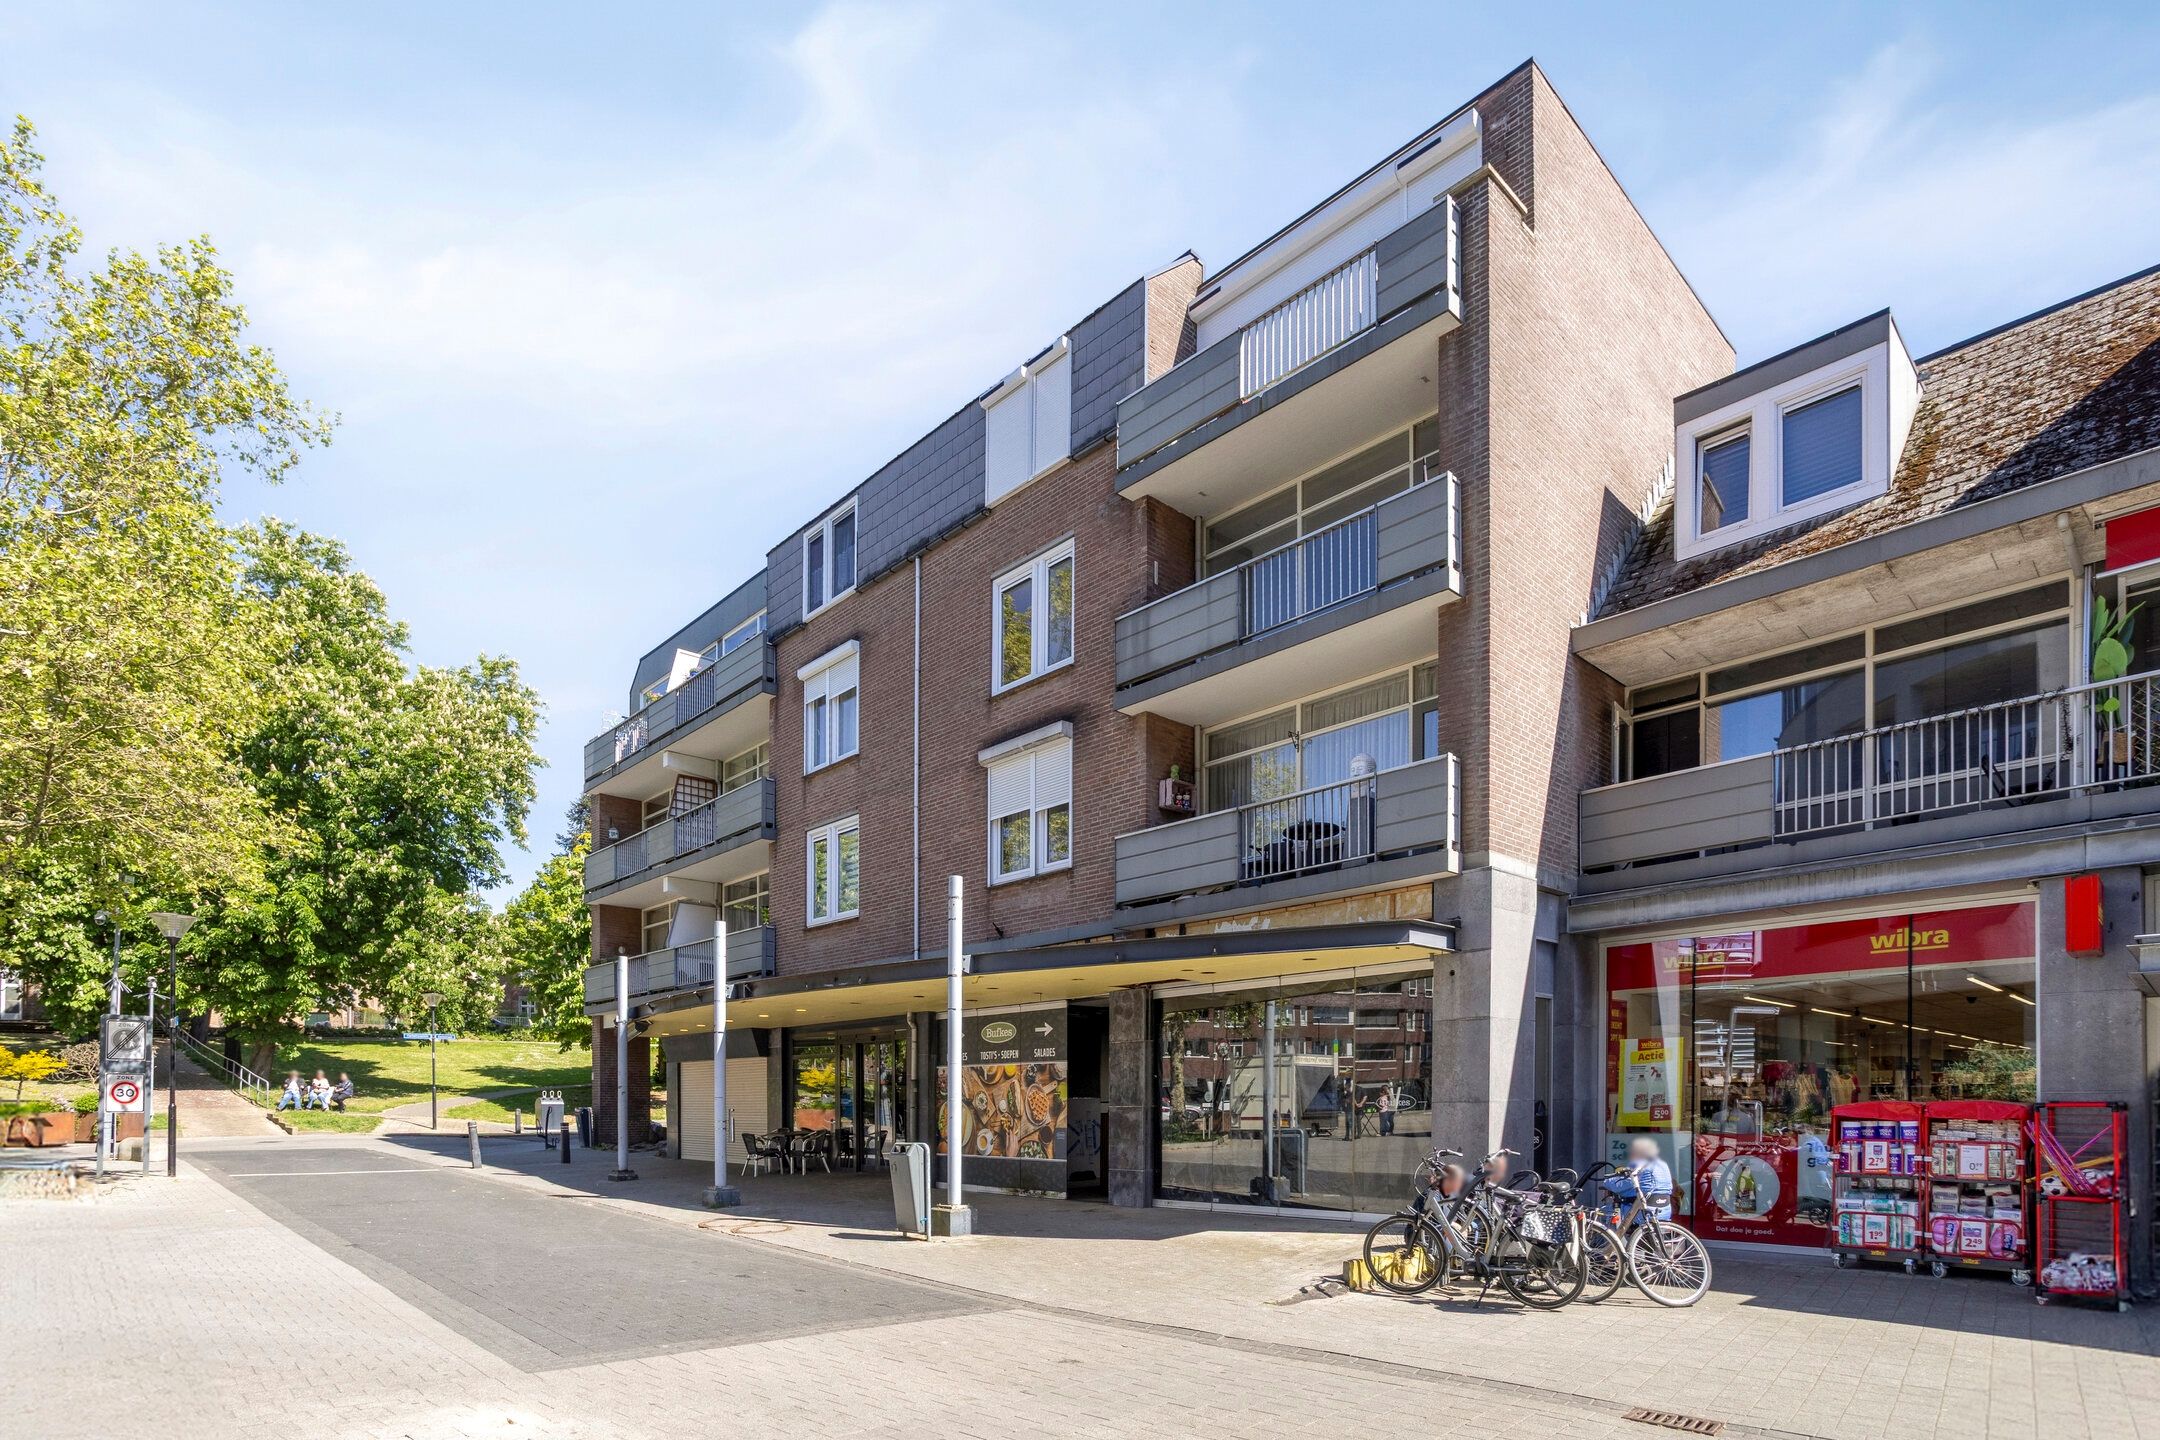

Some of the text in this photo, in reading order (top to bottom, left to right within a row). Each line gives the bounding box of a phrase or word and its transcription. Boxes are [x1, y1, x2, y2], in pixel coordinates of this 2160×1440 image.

[1870, 928, 1949, 950] wibra
[986, 1027, 1013, 1038] Bufkes
[1001, 1050, 1019, 1059] SOEPEN
[1034, 1048, 1056, 1058] SALADES
[1638, 1053, 1664, 1061] Actie
[116, 1088, 134, 1097] 30
[1745, 1227, 1752, 1235] je
[1869, 1230, 1883, 1239] 1.99
[1965, 1238, 1982, 1247] 2.49
